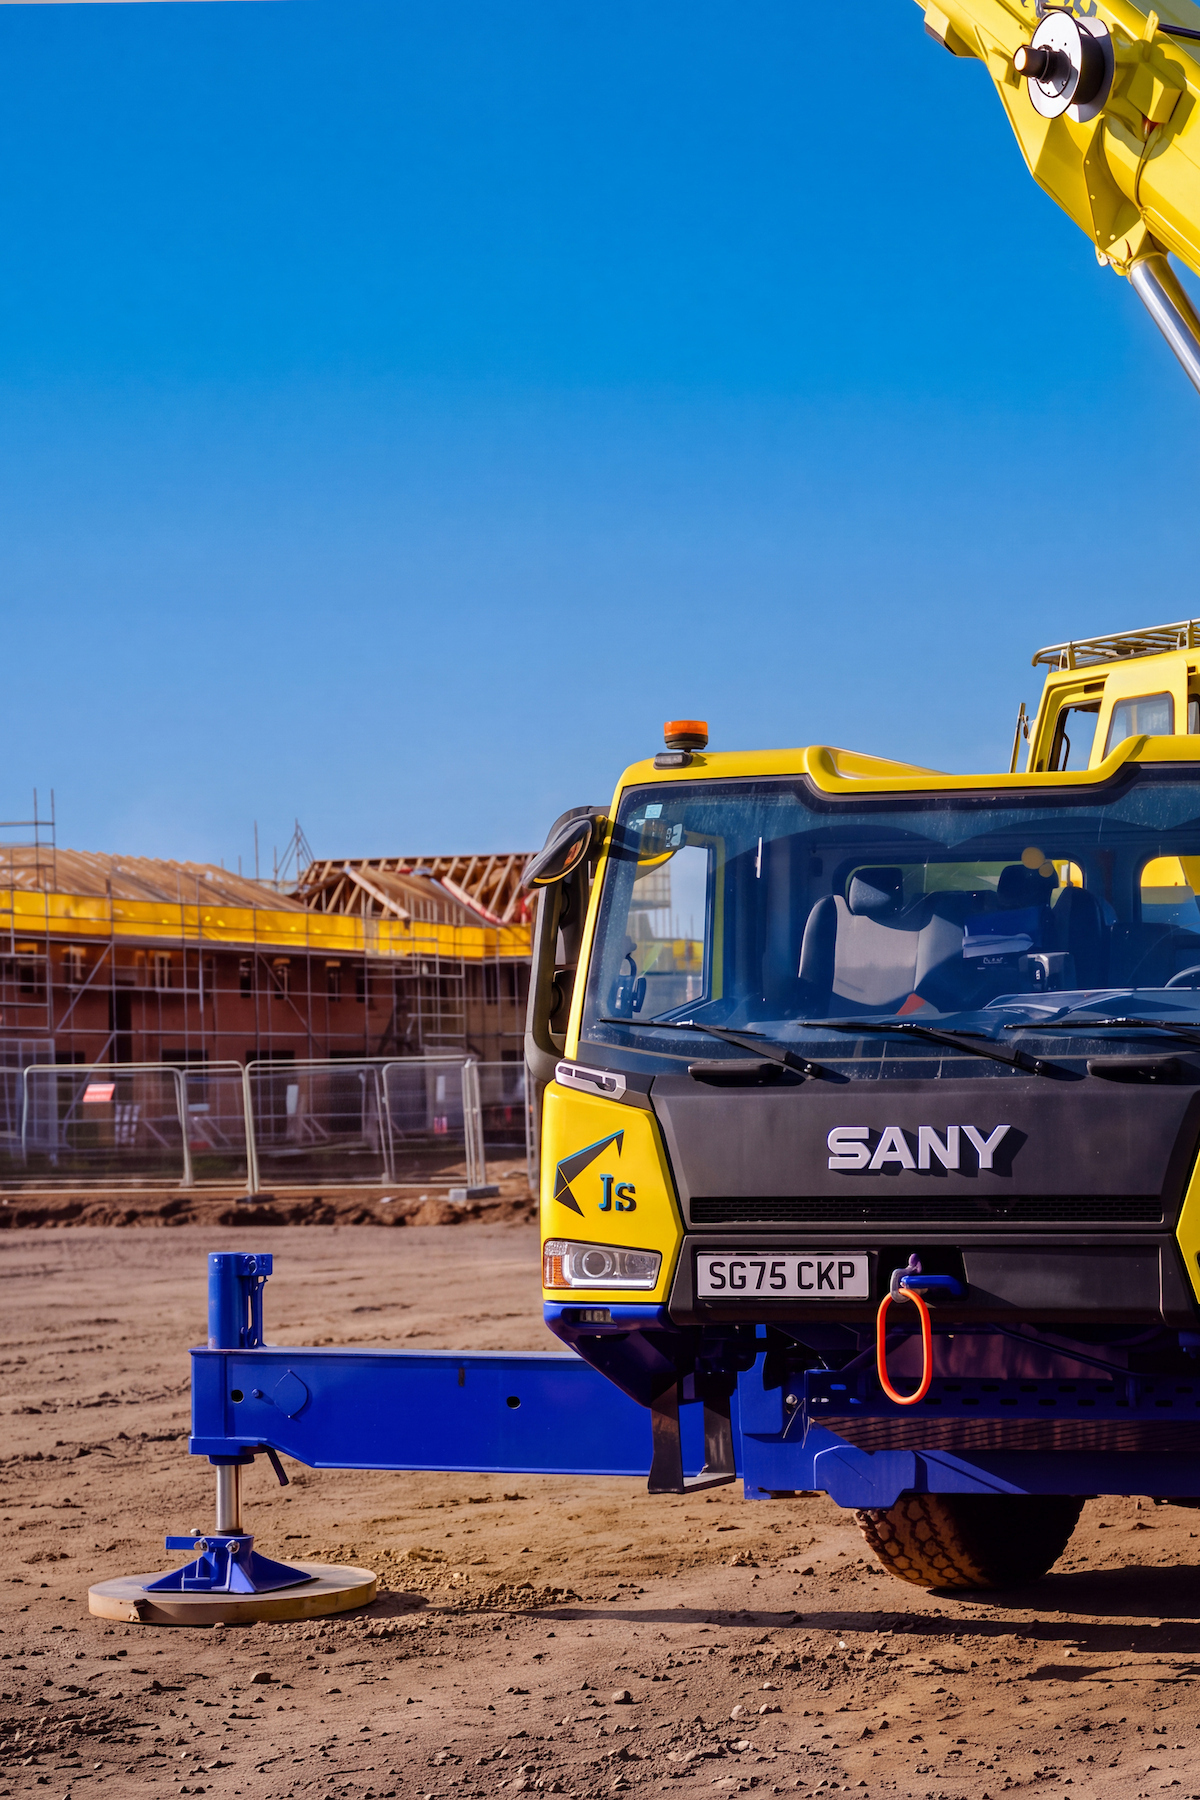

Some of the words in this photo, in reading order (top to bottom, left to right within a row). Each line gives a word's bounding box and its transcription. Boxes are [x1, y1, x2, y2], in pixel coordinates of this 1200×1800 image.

[827, 1124, 1012, 1170] SANY
[709, 1261, 787, 1290] SG75
[797, 1261, 855, 1290] CKP
